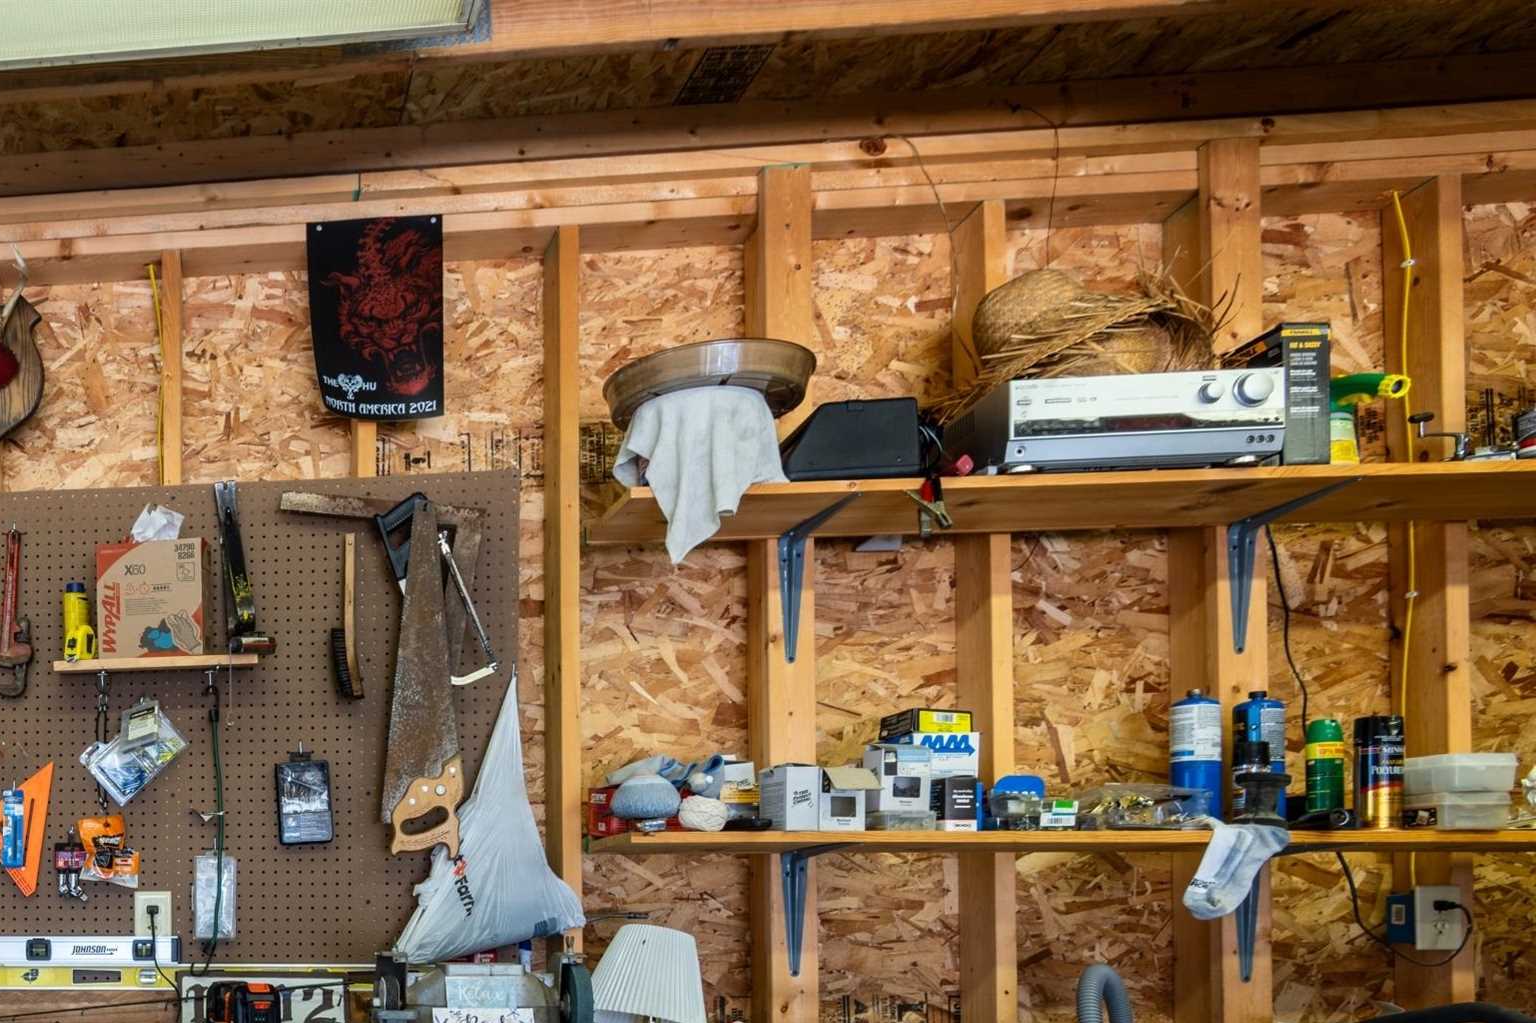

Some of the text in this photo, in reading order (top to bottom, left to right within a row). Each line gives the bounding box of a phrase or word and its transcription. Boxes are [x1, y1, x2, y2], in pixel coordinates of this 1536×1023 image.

[323, 376, 377, 391] THE HU
[325, 395, 437, 415] NORTH AMERICA 2021
[124, 564, 146, 576] X60
[72, 944, 107, 955] JOHNSON
